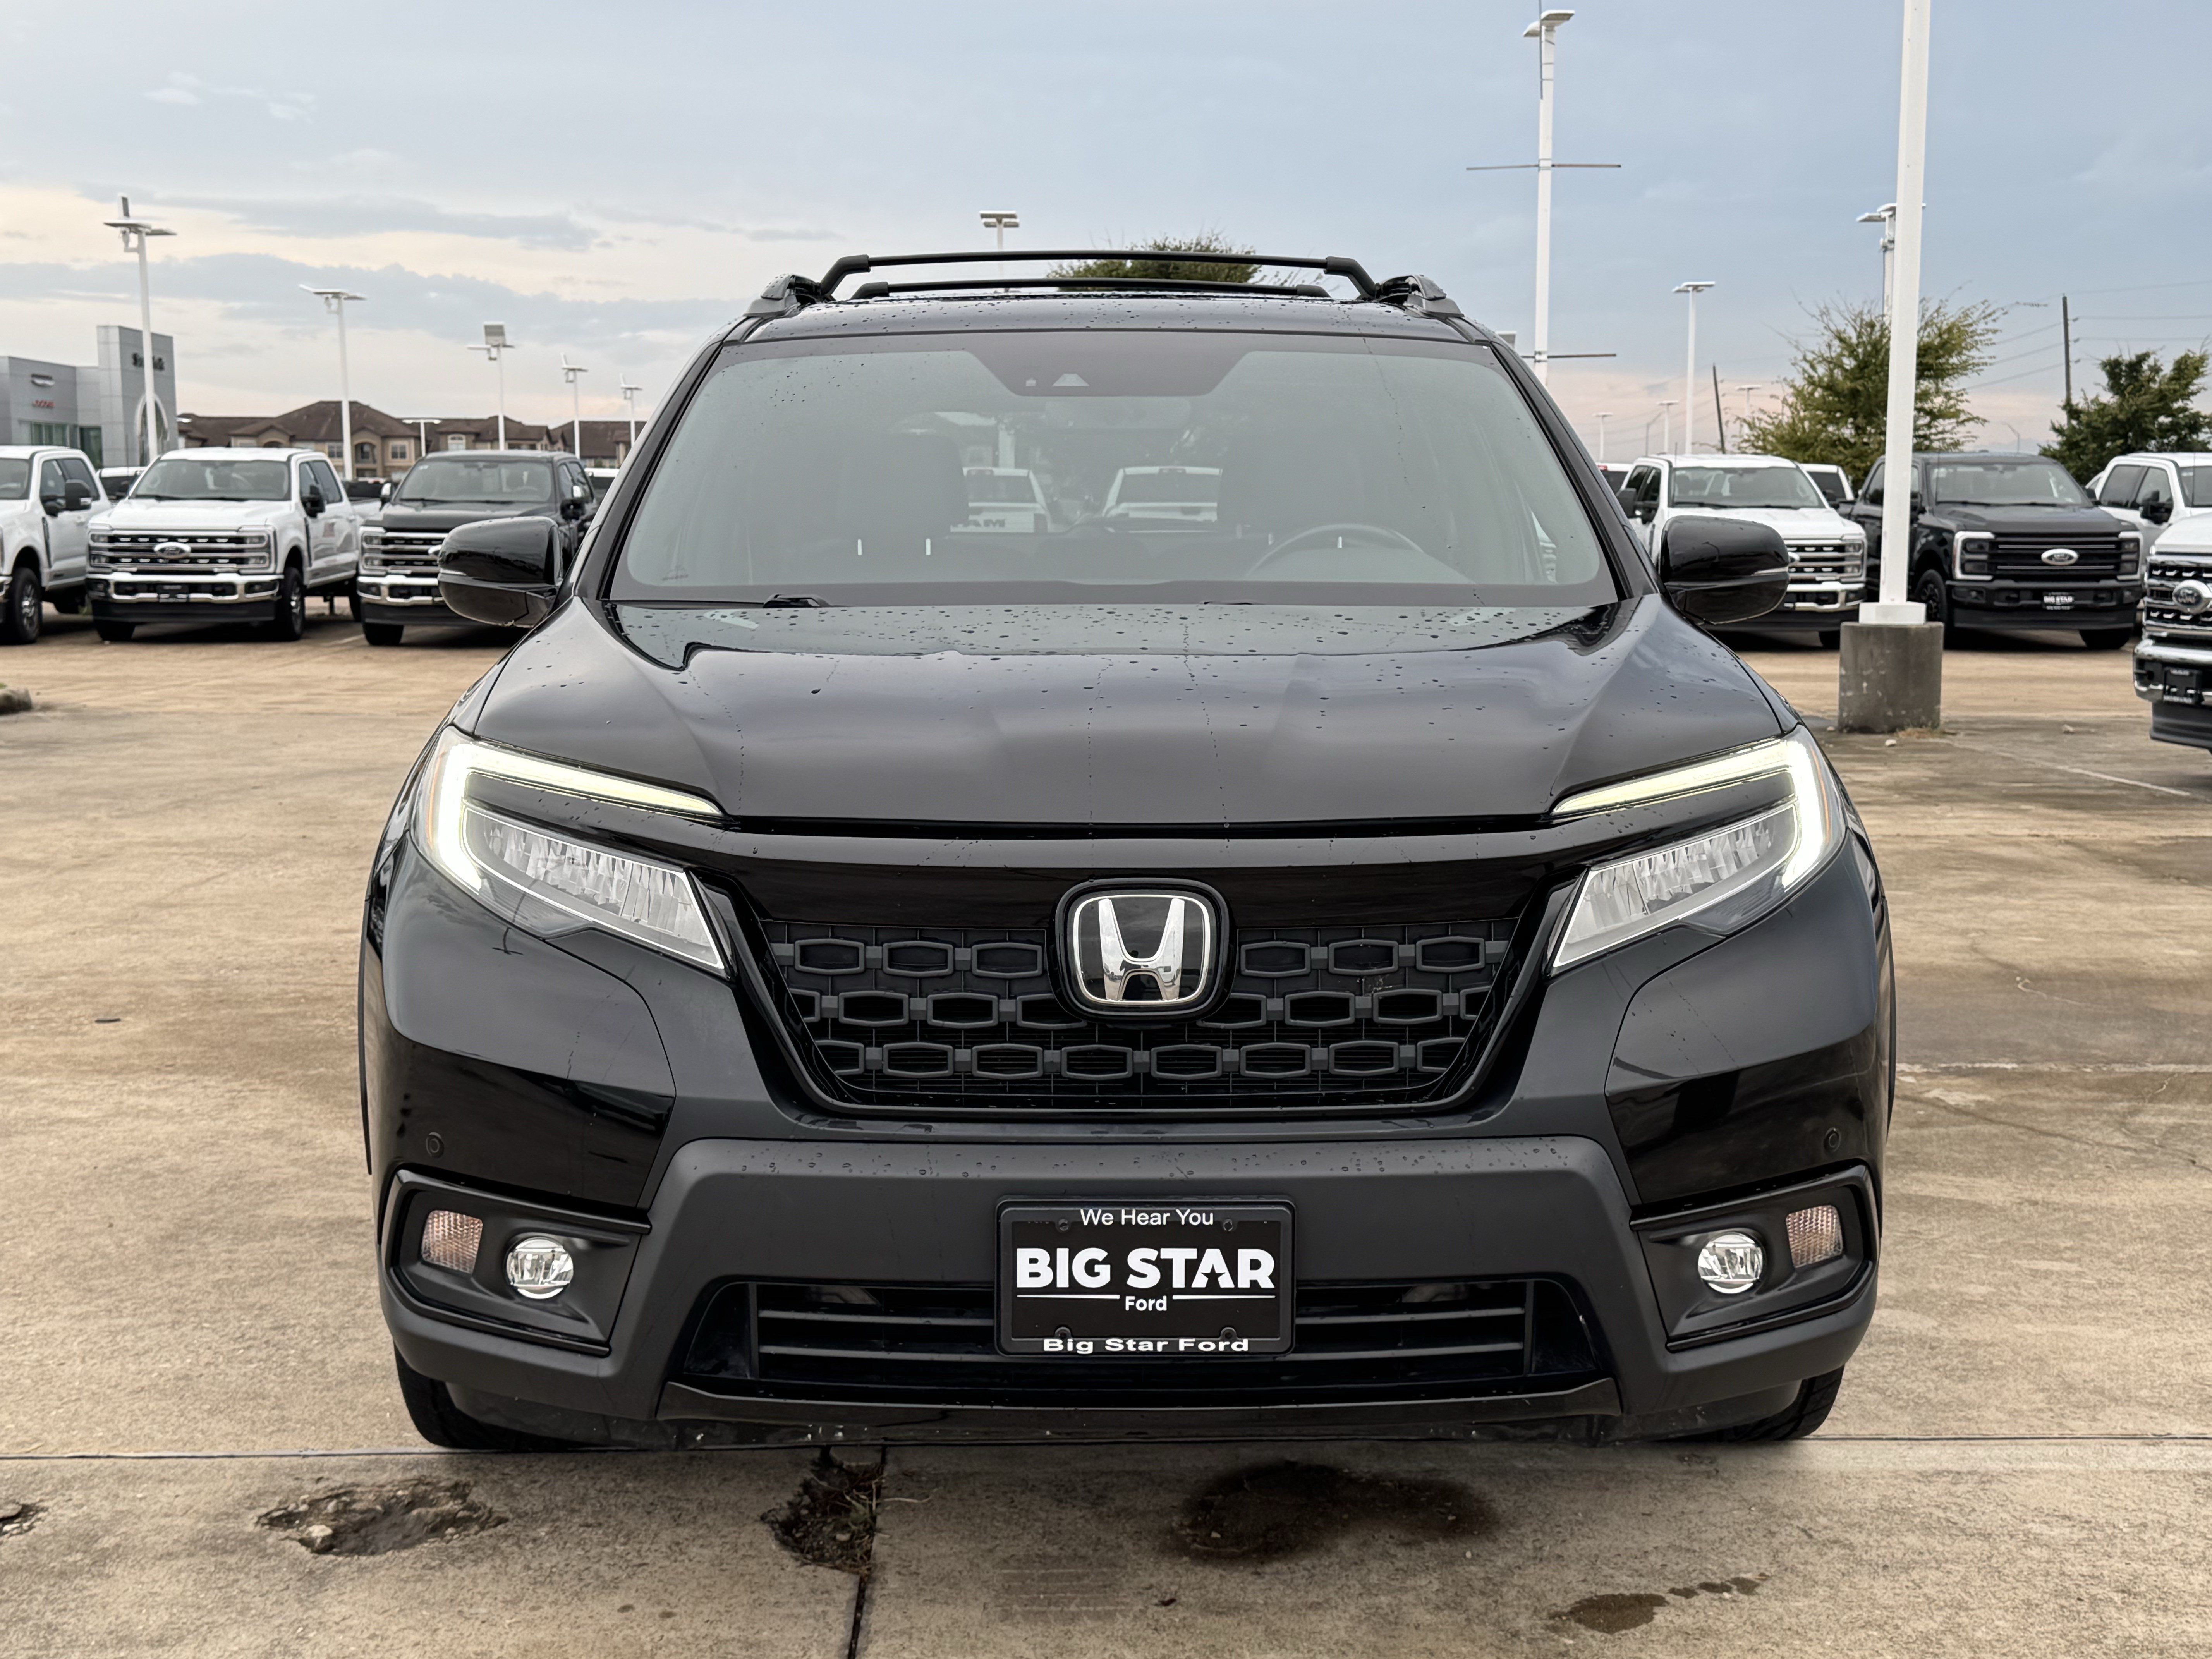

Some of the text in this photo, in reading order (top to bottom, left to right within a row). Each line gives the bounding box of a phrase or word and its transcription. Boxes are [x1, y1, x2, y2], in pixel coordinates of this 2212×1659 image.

[1080, 1209, 1214, 1225] We Hear You
[1017, 1247, 1275, 1288] BIG STAR
[1125, 1295, 1167, 1311] Ford
[1044, 1338, 1249, 1354] Big Star Ford
